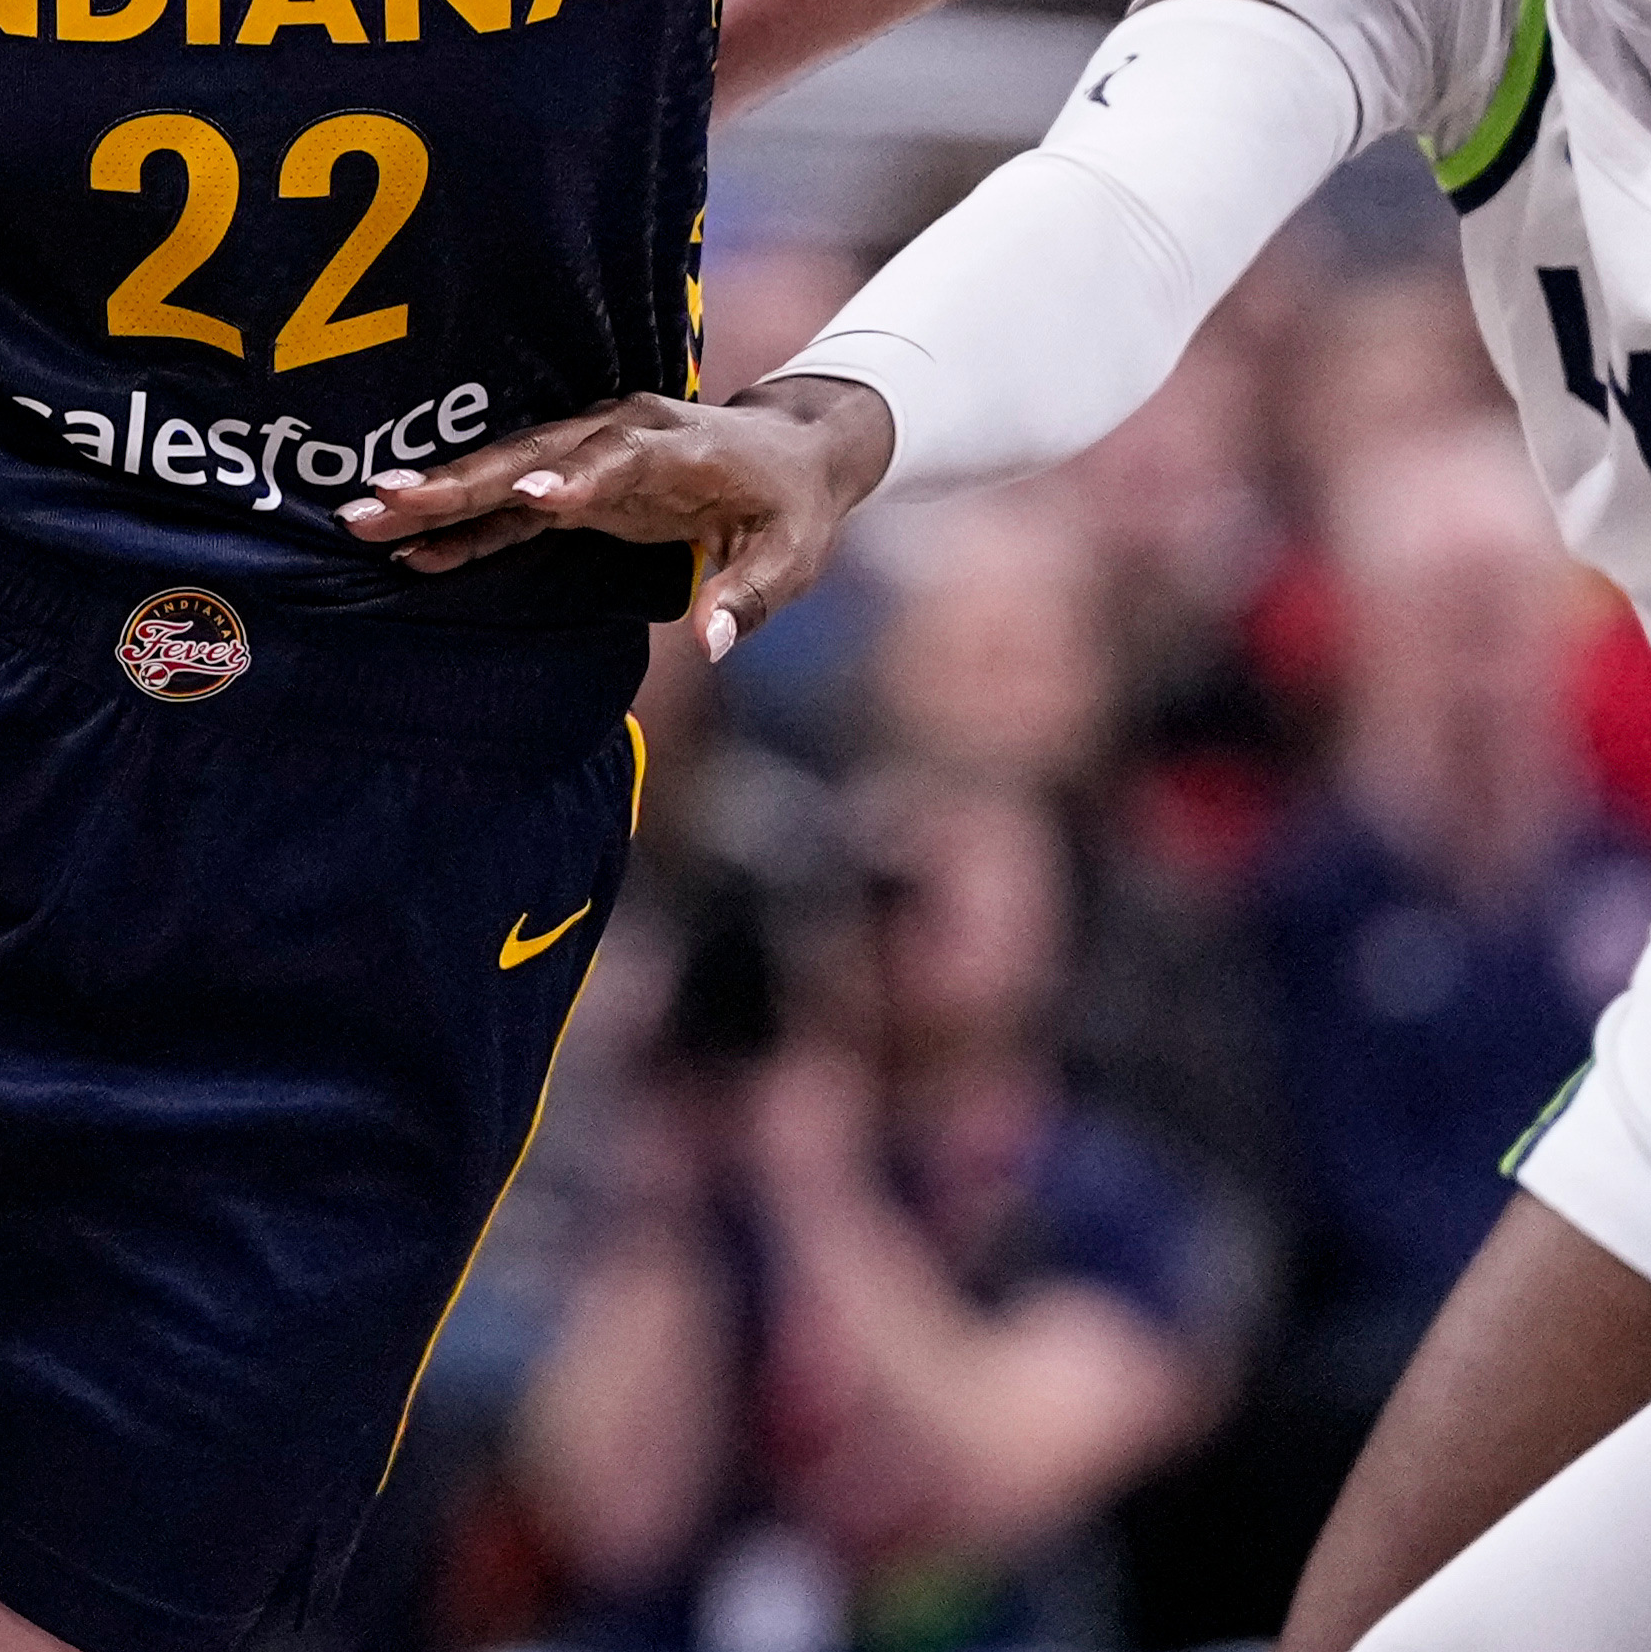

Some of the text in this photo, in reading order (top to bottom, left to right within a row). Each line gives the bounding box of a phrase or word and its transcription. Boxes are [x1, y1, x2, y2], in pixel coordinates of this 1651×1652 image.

[89, 112, 430, 374] 22
[153, 600, 232, 639] INDIANA
[120, 620, 248, 671] Fever
